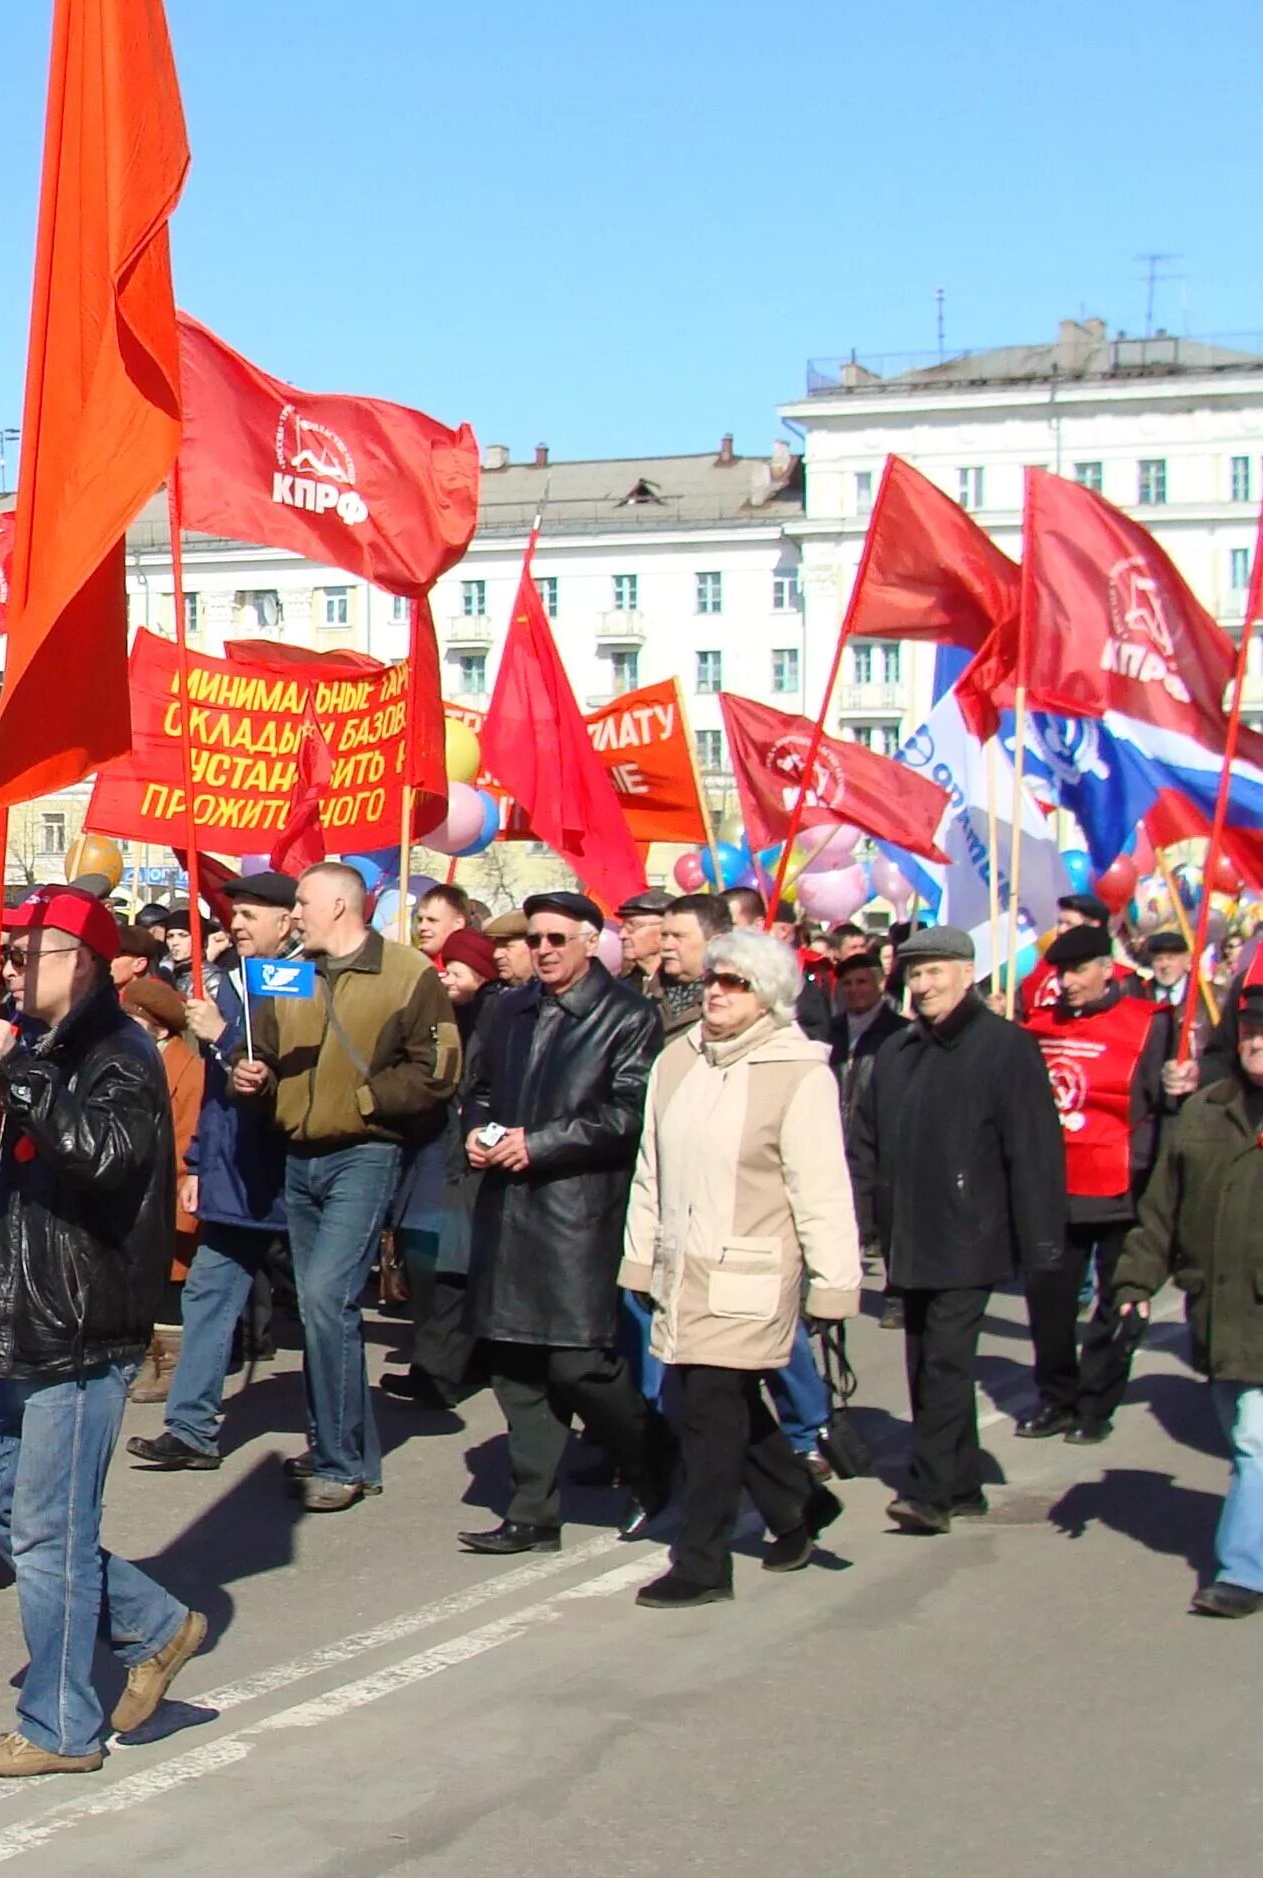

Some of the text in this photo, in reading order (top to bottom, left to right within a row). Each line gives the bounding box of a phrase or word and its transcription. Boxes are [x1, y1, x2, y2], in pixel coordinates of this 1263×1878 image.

[272, 472, 369, 526] КПРФ
[164, 702, 304, 758] ОКЛАДЫ
[338, 702, 406, 751] БАЗОВ
[190, 748, 385, 793] УСТАНИТЬ
